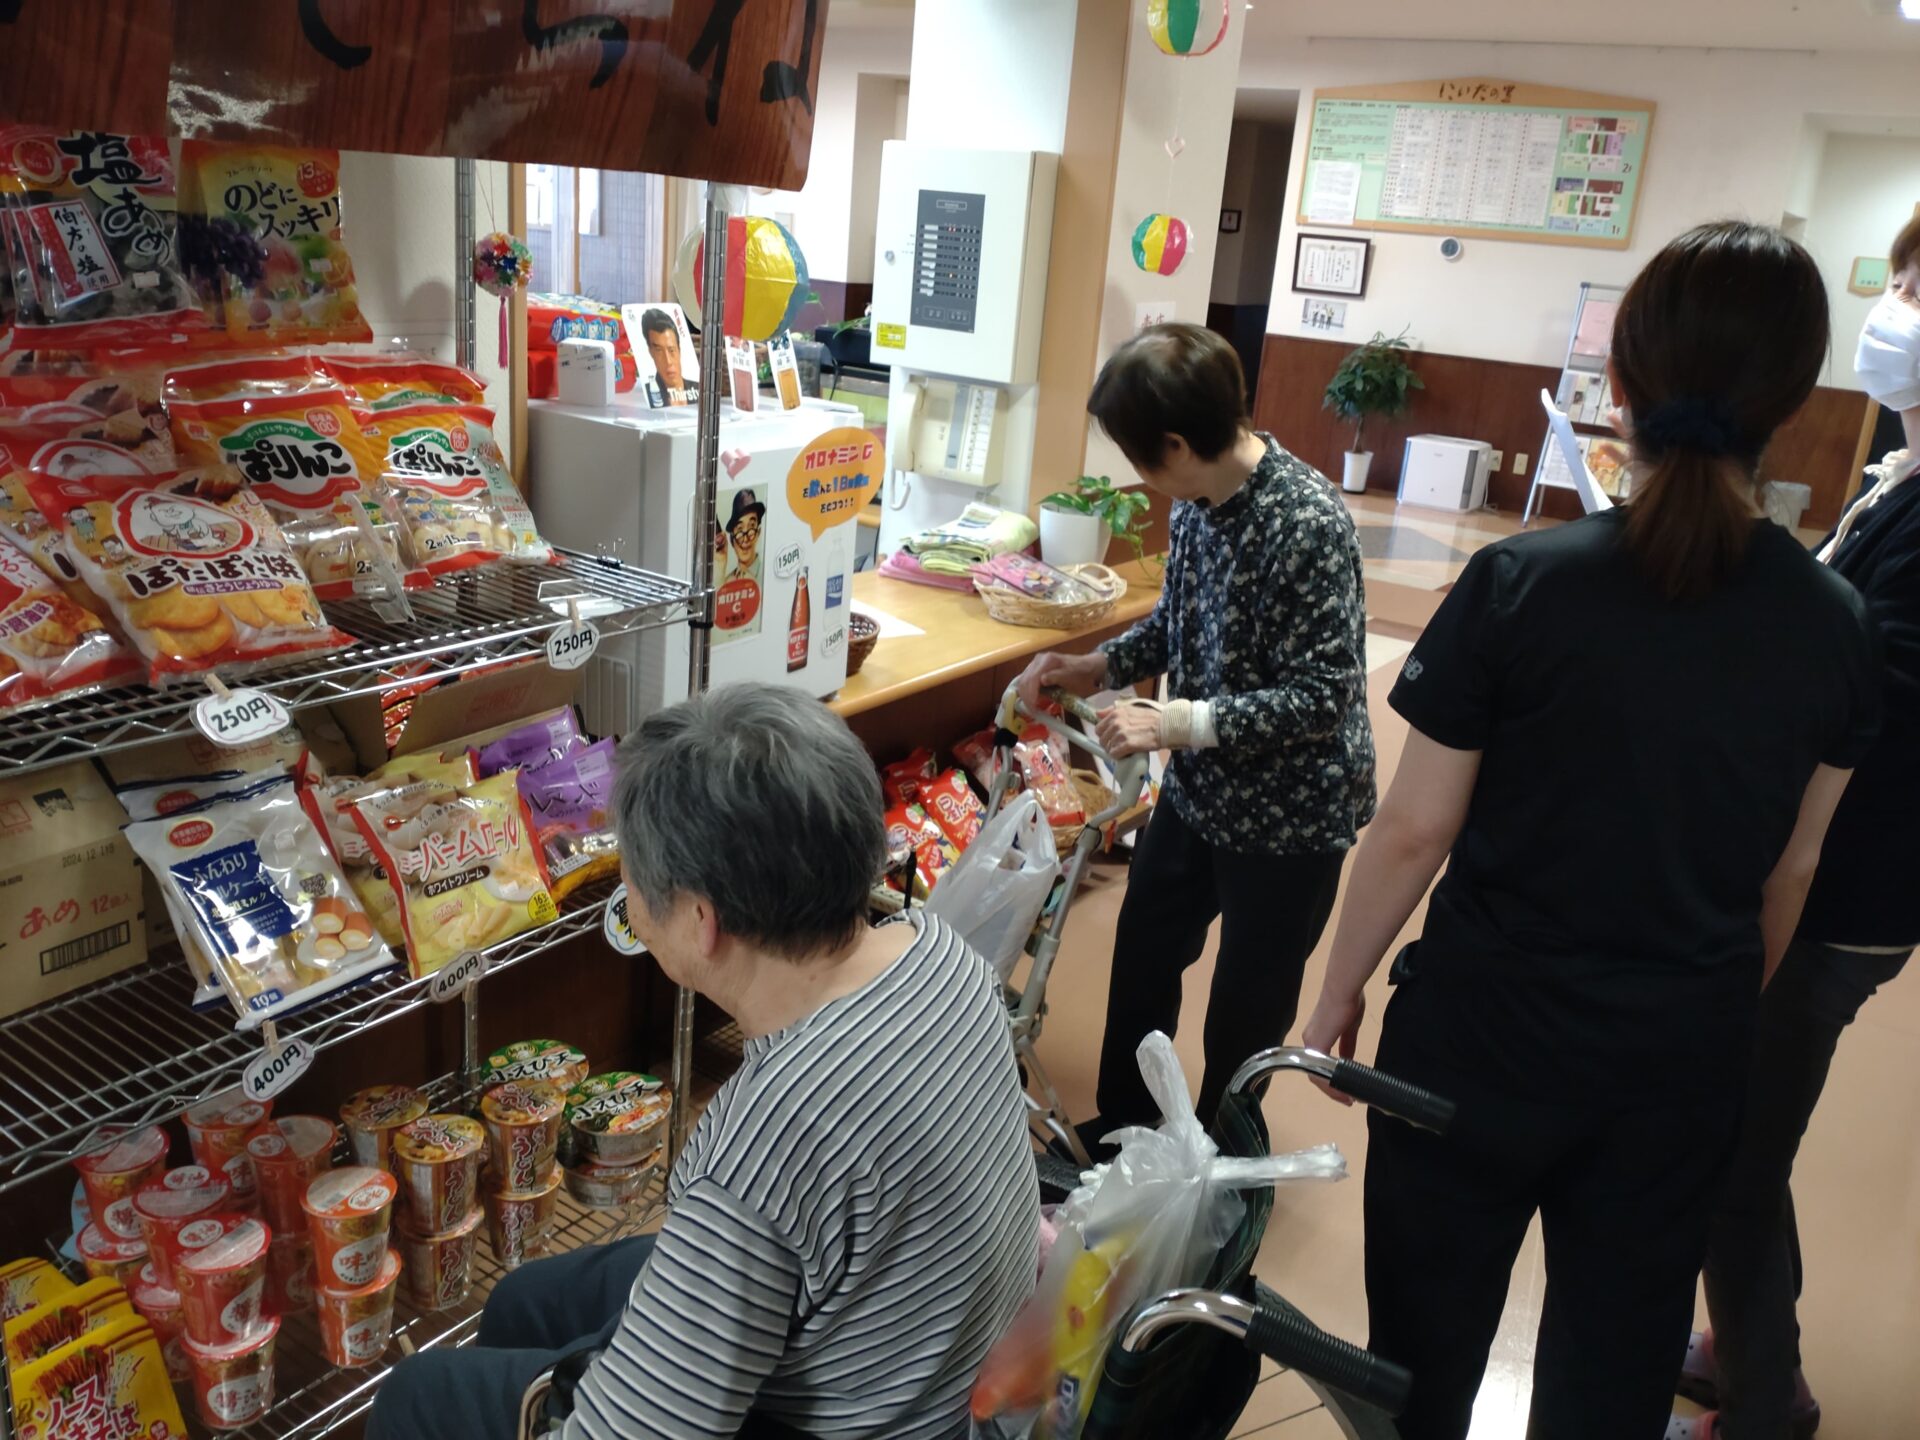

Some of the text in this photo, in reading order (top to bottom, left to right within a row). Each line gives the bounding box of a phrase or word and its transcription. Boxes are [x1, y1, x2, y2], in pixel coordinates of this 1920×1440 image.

[57, 132, 170, 266] 塩あめ
[223, 180, 298, 213] のどに
[258, 197, 342, 240] スッキリ
[54, 207, 104, 277] 伯方の塩
[226, 439, 352, 484] ぱりんこ
[392, 443, 481, 477] ぱりんこ
[805, 446, 859, 469] オロナミン
[126, 553, 303, 597] ぽたぽた焼
[778, 548, 800, 568] 150円
[732, 602, 742, 613] C
[553, 630, 594, 657] 250円
[826, 629, 844, 647] 150円
[211, 697, 272, 734] 250円
[401, 813, 521, 882] ミニバームロール
[427, 869, 486, 895] ホワイトクリーム
[20, 899, 80, 939] あめ
[438, 955, 479, 994] 400円
[253, 1044, 301, 1094] 400円
[489, 1050, 575, 1083] 小えび天
[574, 1081, 653, 1121] 小えび天
[35, 1374, 105, 1430] ソース
